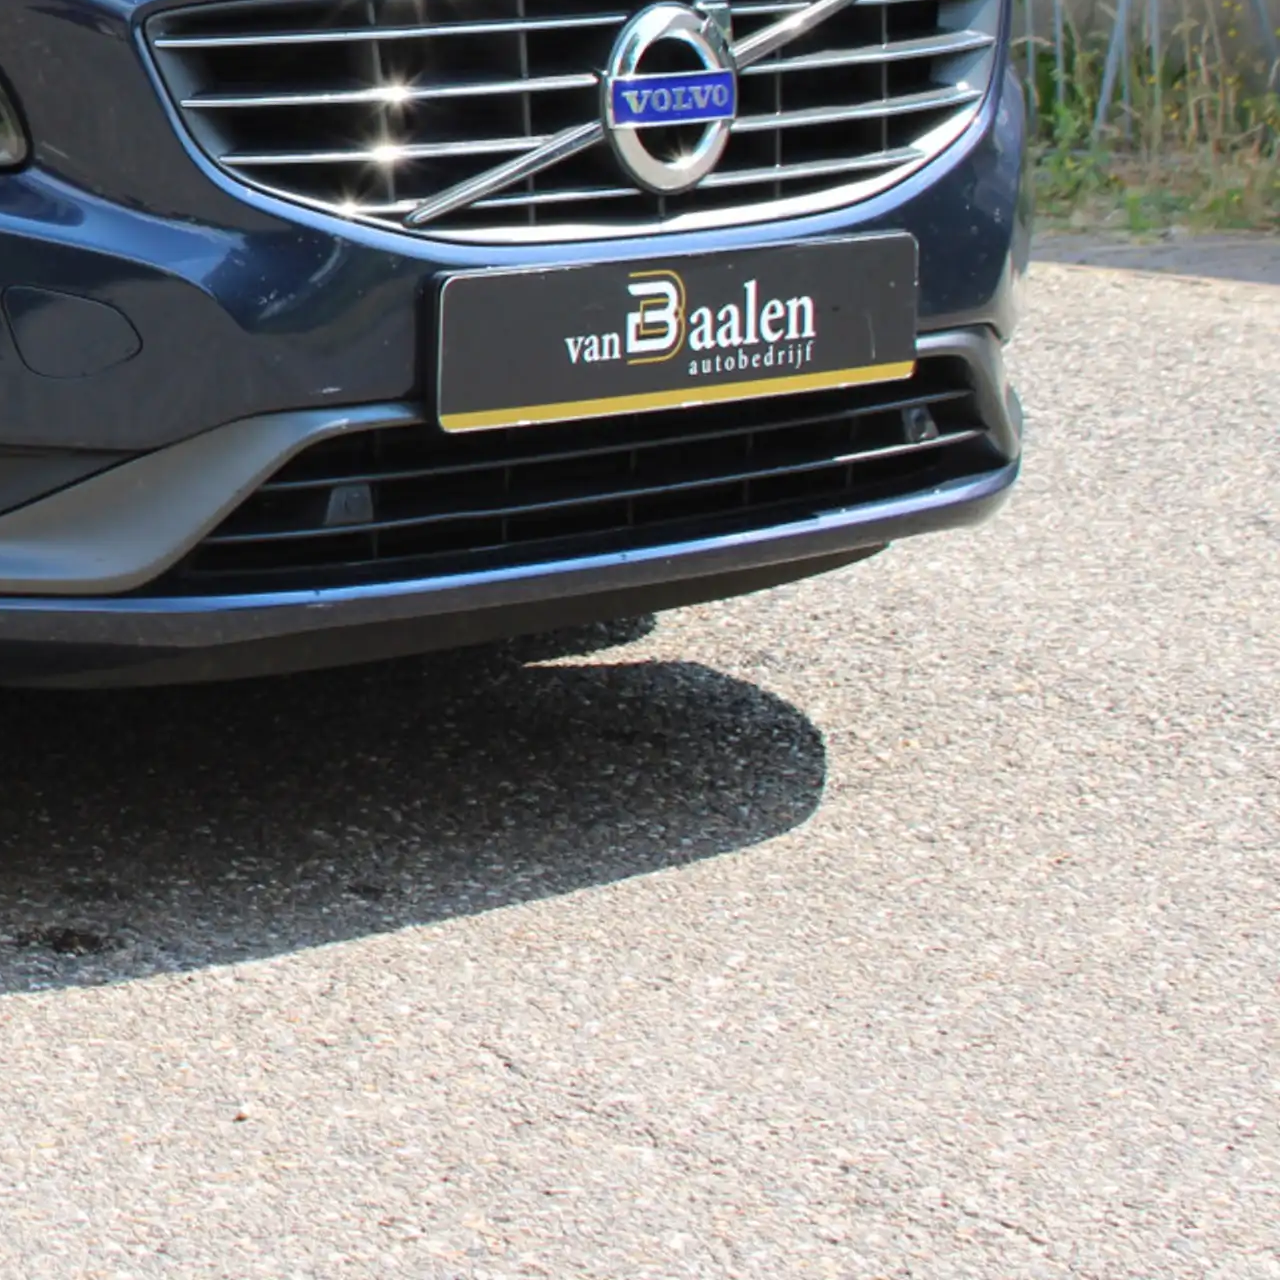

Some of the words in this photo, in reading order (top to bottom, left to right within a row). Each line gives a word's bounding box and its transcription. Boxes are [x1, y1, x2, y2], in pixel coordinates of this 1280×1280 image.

[621, 84, 729, 114] VOLVO
[564, 331, 622, 365] van
[626, 273, 816, 360] Baalen
[688, 340, 815, 376] autobedrijf
